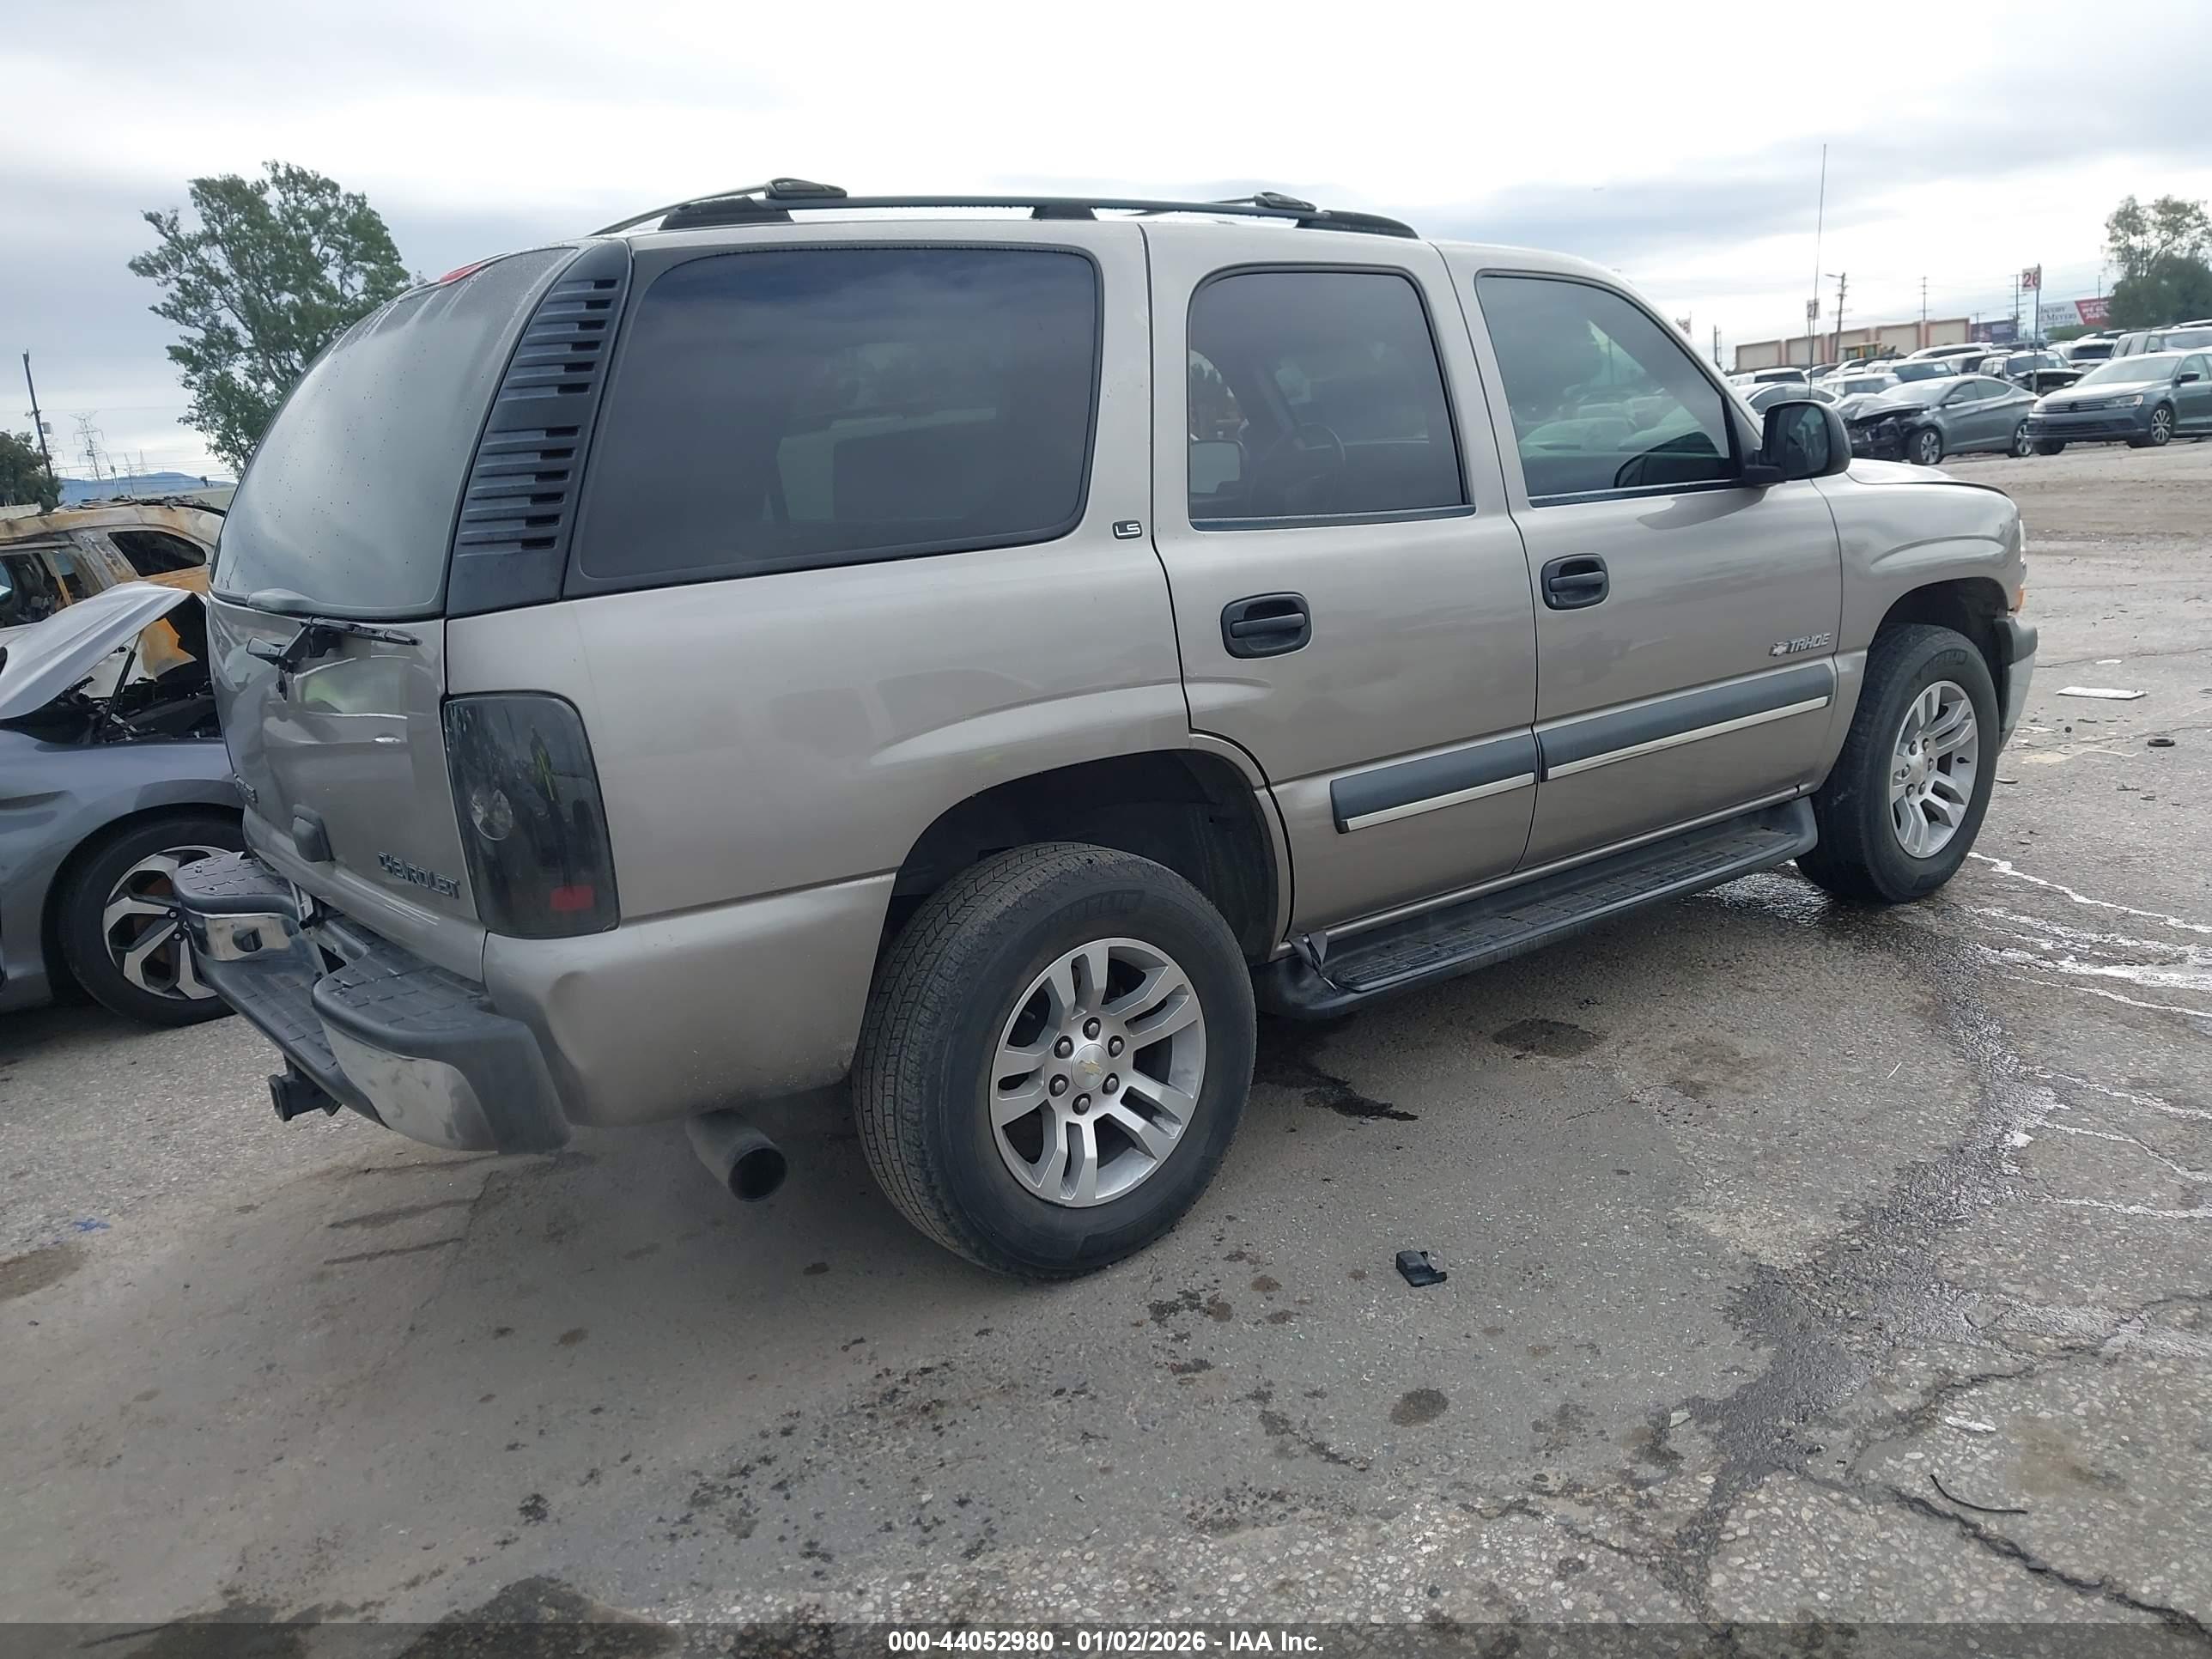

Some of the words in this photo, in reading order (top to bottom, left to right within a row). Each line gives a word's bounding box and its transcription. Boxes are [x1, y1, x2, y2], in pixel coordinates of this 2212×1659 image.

[1115, 523, 1141, 536] LS
[1788, 632, 1832, 653] TAHOE
[378, 851, 460, 899] CHEVROLET
